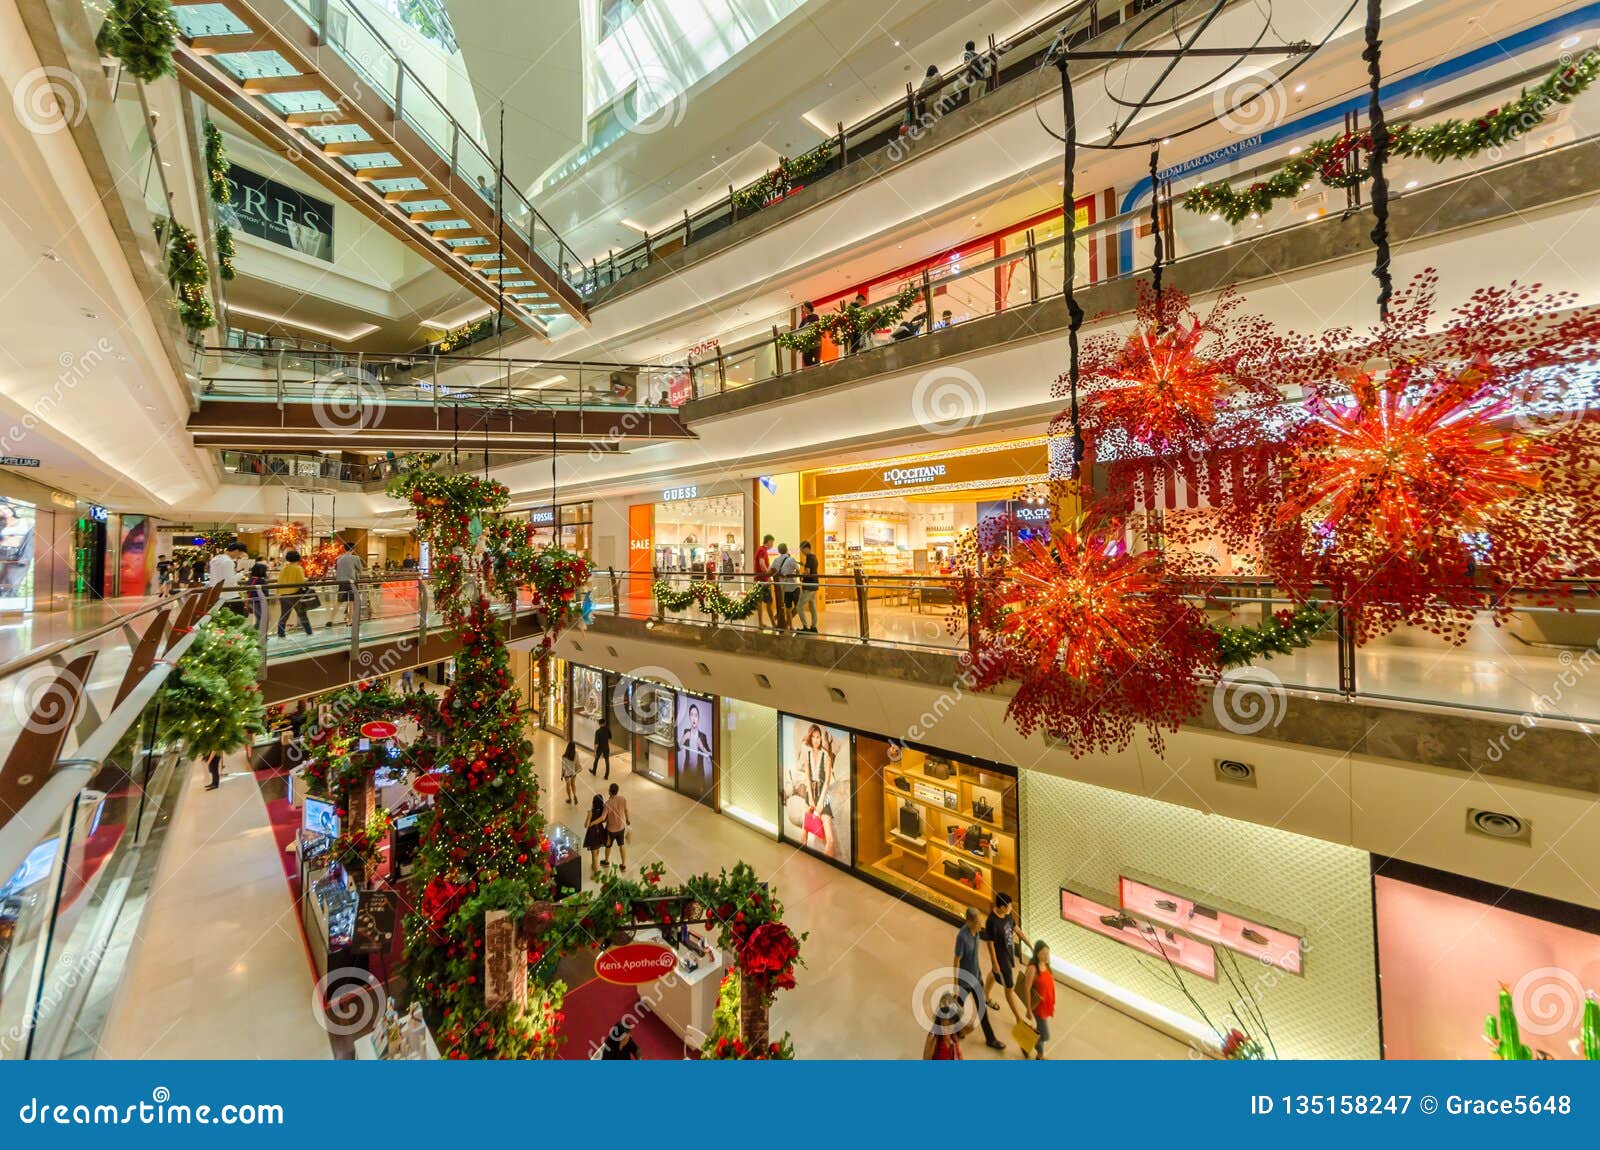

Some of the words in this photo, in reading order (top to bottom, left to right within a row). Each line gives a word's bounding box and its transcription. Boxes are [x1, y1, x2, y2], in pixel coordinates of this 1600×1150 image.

[1183, 145, 1239, 172] BARANGAN
[1240, 135, 1262, 151] BAYI
[672, 387, 690, 402] SALE
[884, 465, 946, 481] L'OCCITANE
[663, 486, 697, 500] GUESS
[630, 538, 650, 551] SALE
